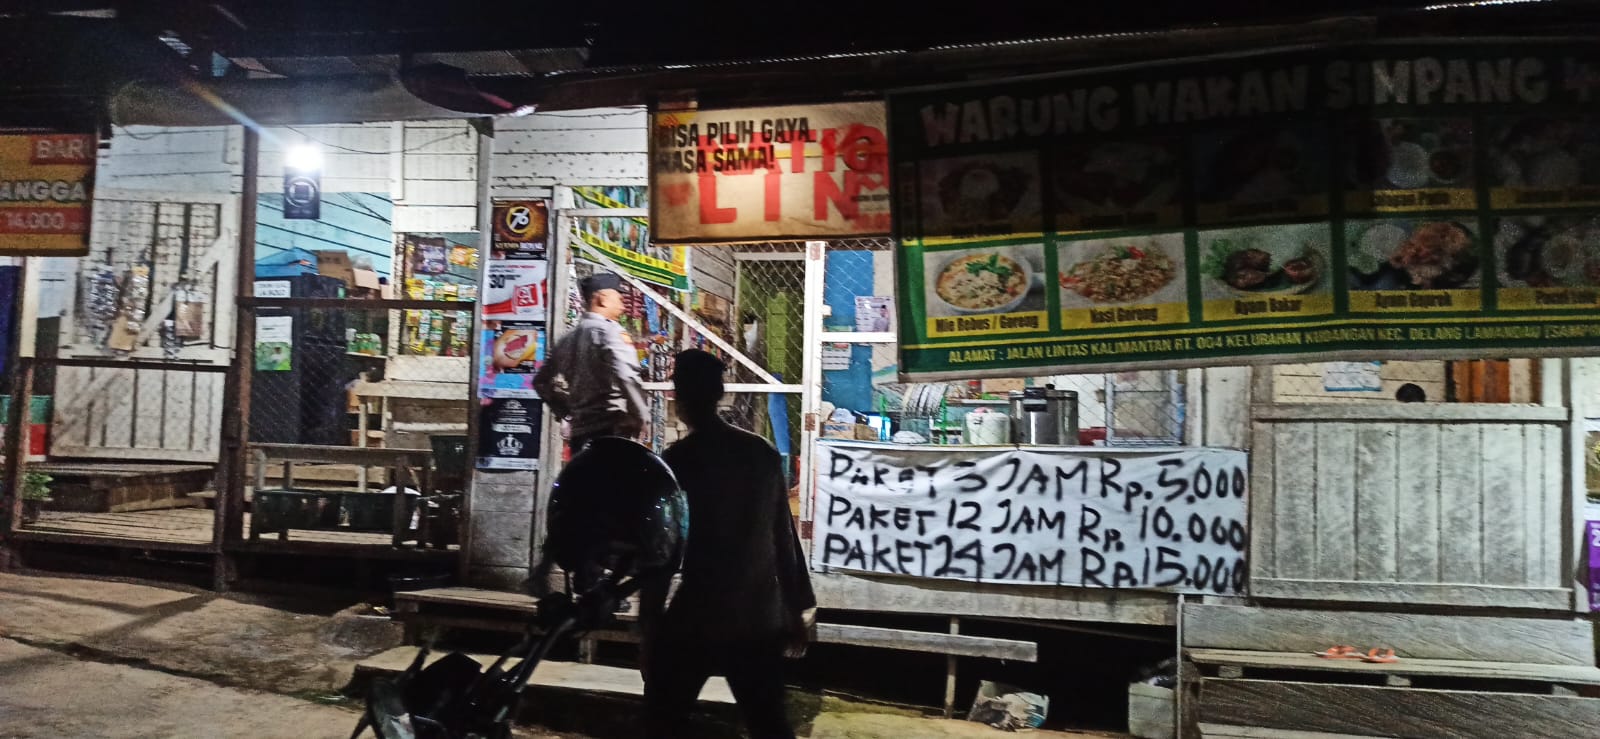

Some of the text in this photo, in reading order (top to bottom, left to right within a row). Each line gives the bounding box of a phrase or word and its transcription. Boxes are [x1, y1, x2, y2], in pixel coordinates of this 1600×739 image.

[920, 86, 1119, 147] WARUNG
[1132, 64, 1312, 127] MAKAN
[1327, 56, 1550, 110] SIMPANG
[707, 121, 754, 146] PILIH
[761, 117, 817, 144] GAYA
[713, 145, 775, 172] SAMA!
[1091, 306, 1158, 323] Nasi Goreng
[1235, 297, 1302, 315] Ayam Bakar
[936, 318, 954, 333] Mie
[959, 316, 990, 332] Rebus
[1001, 313, 1039, 331] Goreng
[949, 349, 997, 363] ALAMAT
[1006, 345, 1044, 361] JALAN
[1047, 342, 1089, 358] LINTAS
[1092, 337, 1170, 356] KALIMANTAN
[1227, 331, 1302, 348] KELURAHAN
[997, 457, 1088, 503] JAM
[1157, 458, 1246, 504] 5.000
[827, 493, 937, 536] PAKET
[947, 498, 982, 531] 12
[991, 498, 1066, 541] JAM
[822, 532, 934, 577] PAKET
[933, 534, 984, 584] 24
[992, 542, 1066, 586] JAM
